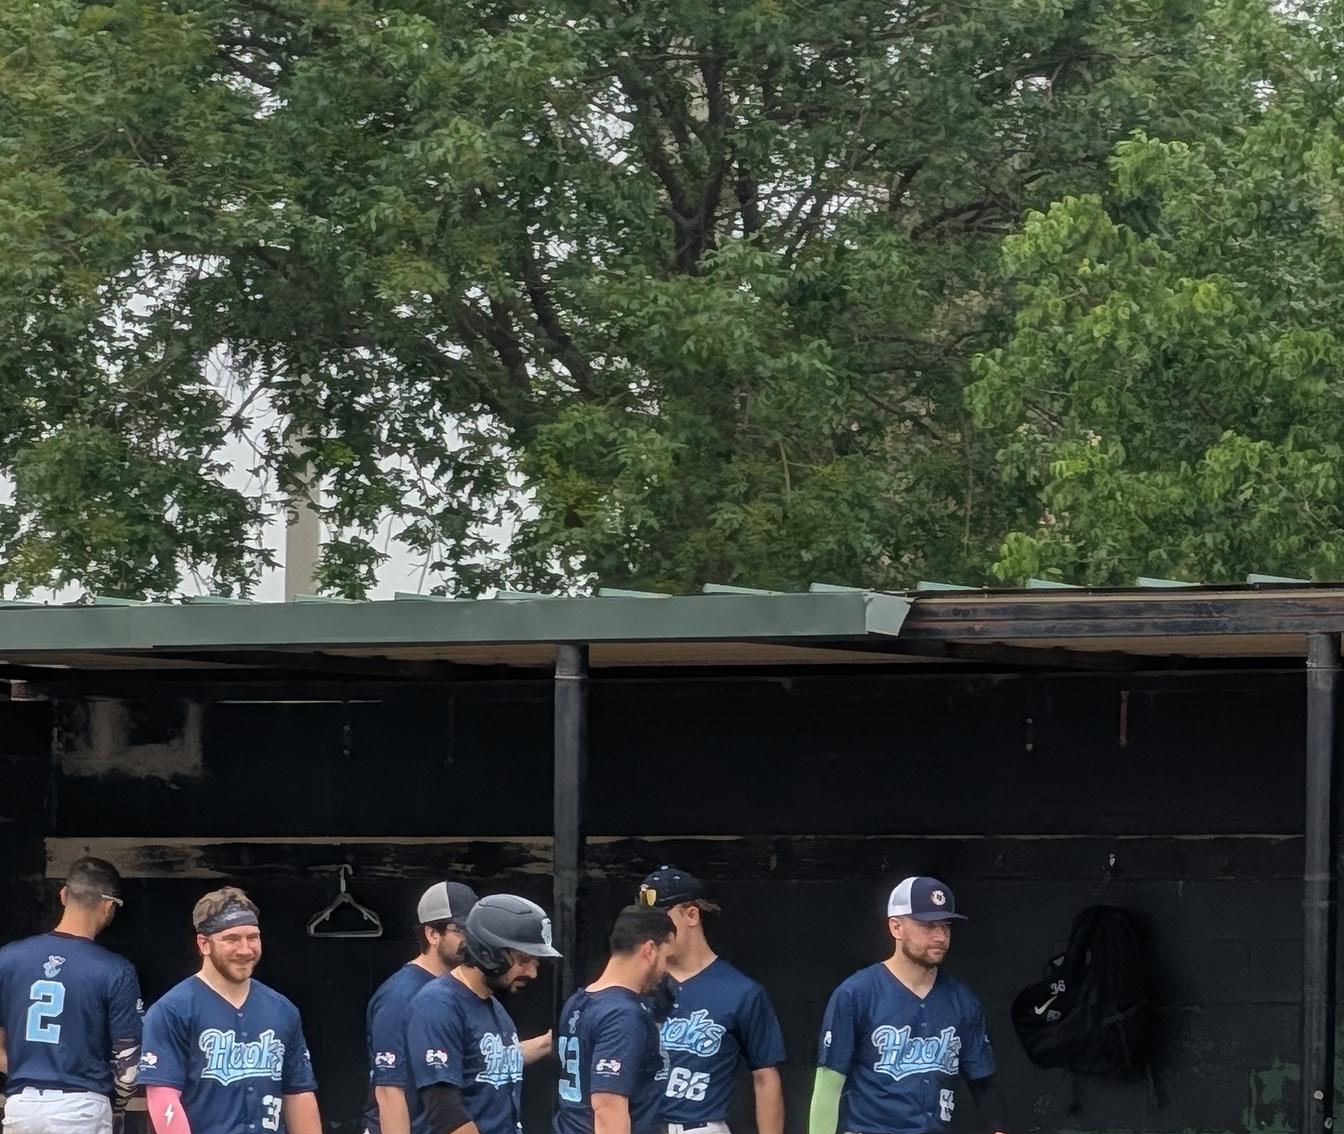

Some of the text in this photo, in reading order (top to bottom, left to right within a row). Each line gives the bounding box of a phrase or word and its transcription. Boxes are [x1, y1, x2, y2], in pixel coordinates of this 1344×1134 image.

[25, 979, 66, 1044] 2
[659, 1008, 727, 1057] oks
[665, 1066, 711, 1102] 66
[262, 1094, 283, 1132] 3
